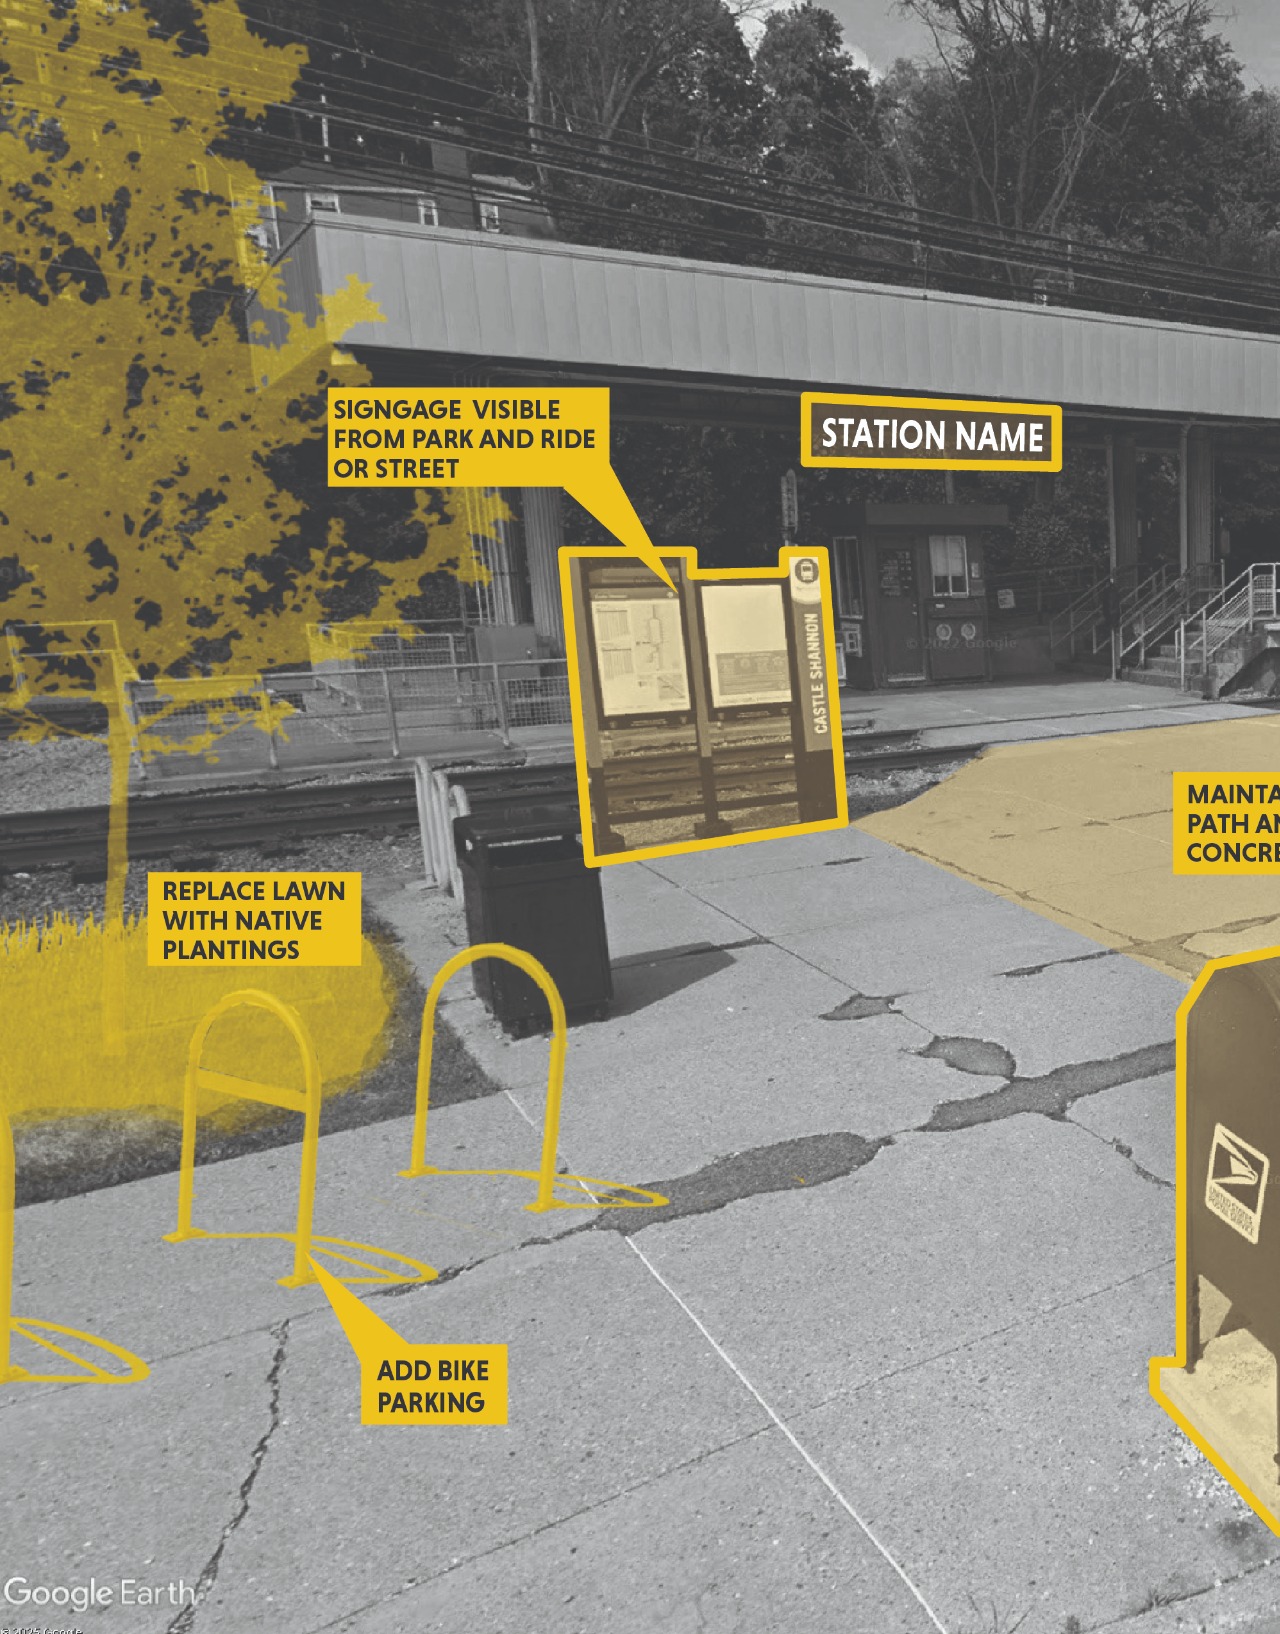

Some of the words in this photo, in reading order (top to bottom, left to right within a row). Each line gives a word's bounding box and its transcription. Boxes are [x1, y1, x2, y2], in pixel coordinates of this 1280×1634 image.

[803, 612, 824, 680] SHANNON
[811, 682, 828, 735] CASTLE
[1208, 1186, 1231, 1210] UNITED
